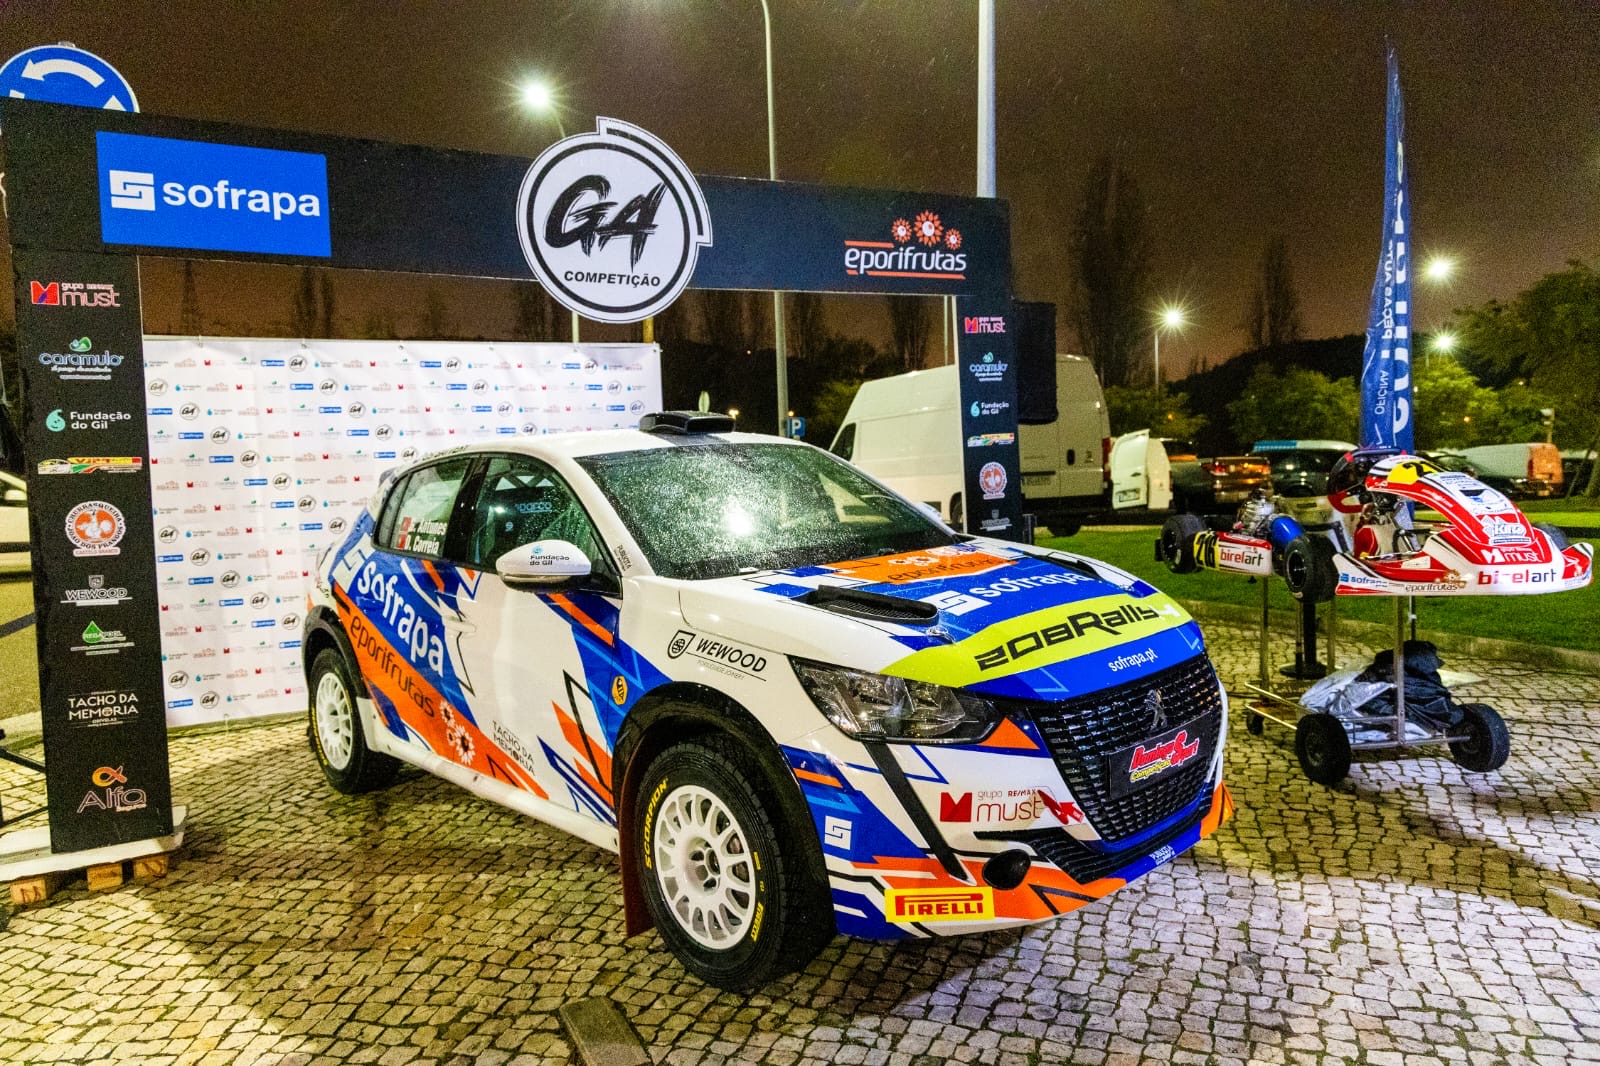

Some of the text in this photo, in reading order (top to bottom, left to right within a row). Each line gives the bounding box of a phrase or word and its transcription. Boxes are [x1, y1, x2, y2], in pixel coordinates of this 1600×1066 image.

[163, 180, 321, 221] sofrapa
[545, 174, 668, 272] GA
[844, 246, 967, 274] eporifrutas
[564, 270, 661, 288] COMPETIÇÃO
[61, 288, 121, 307] must
[979, 320, 1006, 333] must
[39, 350, 122, 366] caramulo
[981, 402, 1010, 410] Fundação
[70, 411, 132, 422] Fundação
[71, 420, 109, 430] do Gil
[791, 419, 801, 434] P
[412, 535, 440, 556] Correia
[530, 554, 570, 562] Fundação
[1220, 549, 1264, 567] birelart
[1504, 551, 1540, 563] must
[969, 570, 1092, 598] sofrapa
[1405, 582, 1458, 593] eporifrutas
[65, 587, 128, 600] WEWOOD
[357, 560, 444, 678] sofrapa
[696, 638, 768, 673] WEWOOD
[1108, 647, 1158, 673] sofrapa.pt
[350, 615, 435, 718] eporifrutas
[68, 693, 139, 708] TACHO DA
[68, 705, 139, 720] MEMORIA
[492, 720, 521, 752] TACHO
[76, 785, 148, 814] Alfa
[977, 788, 1037, 801] grupo RE/MAX
[976, 797, 1044, 822] must
[644, 778, 669, 870] SCORPION
[895, 893, 984, 916] PIRELLI
